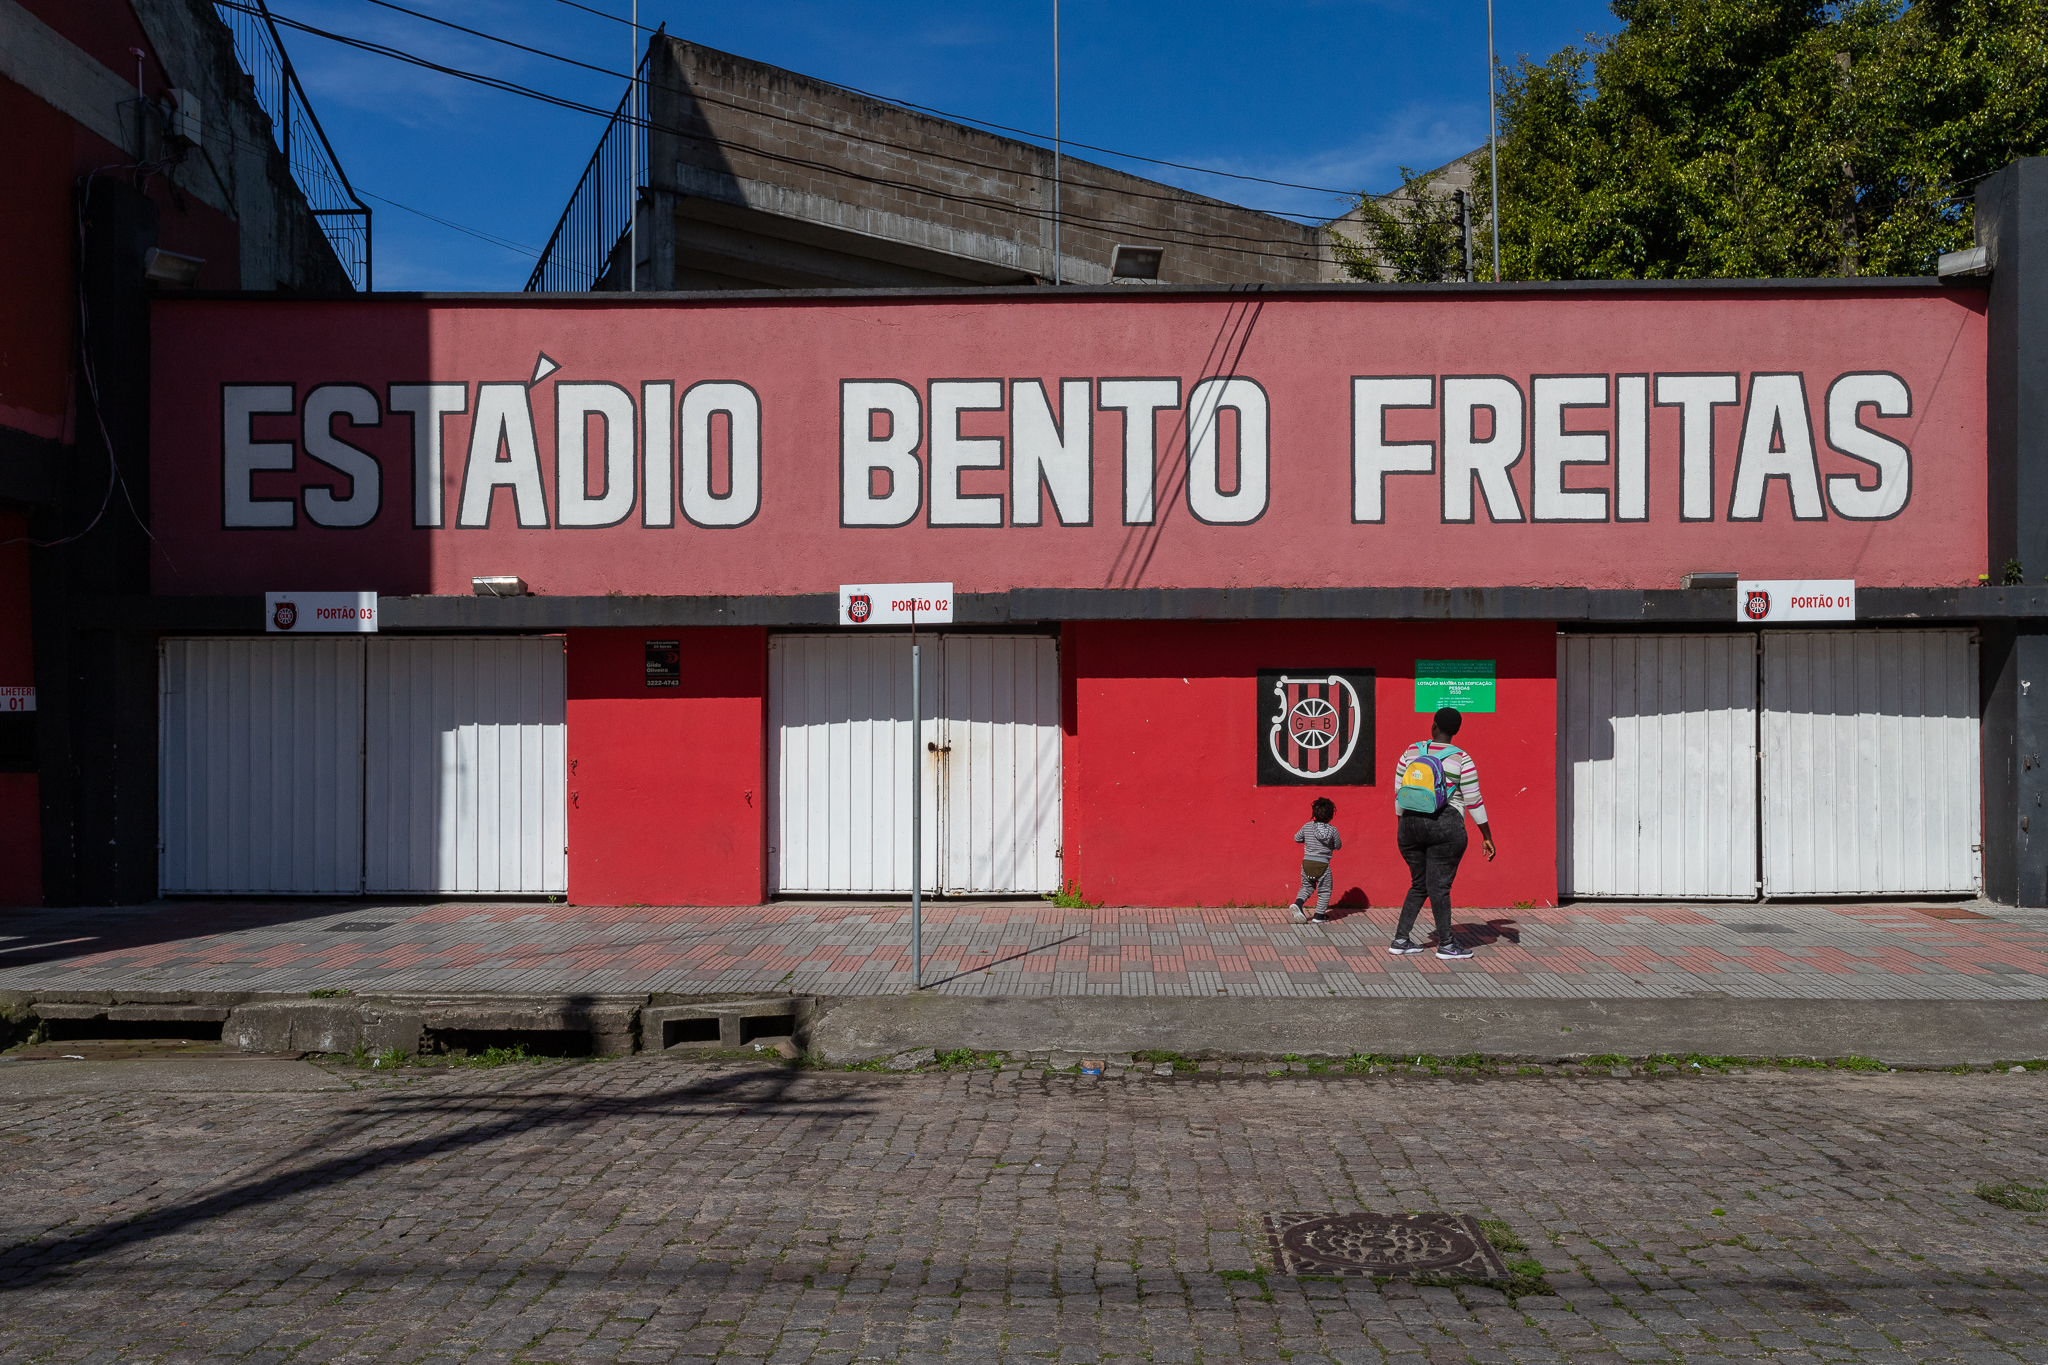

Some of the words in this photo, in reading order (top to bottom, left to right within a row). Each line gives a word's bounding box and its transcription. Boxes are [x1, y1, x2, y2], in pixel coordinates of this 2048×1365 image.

[220, 351, 762, 530] ESTÁDIO
[839, 375, 1271, 529] BENTO
[1350, 370, 1912, 524] FREITAS
[935, 599, 948, 611] 02
[1791, 594, 1833, 608] PORTÃO
[1837, 596, 1850, 608] 01
[316, 606, 356, 619] PORTÃO
[359, 608, 372, 619] 03
[9, 697, 24, 711] 01
